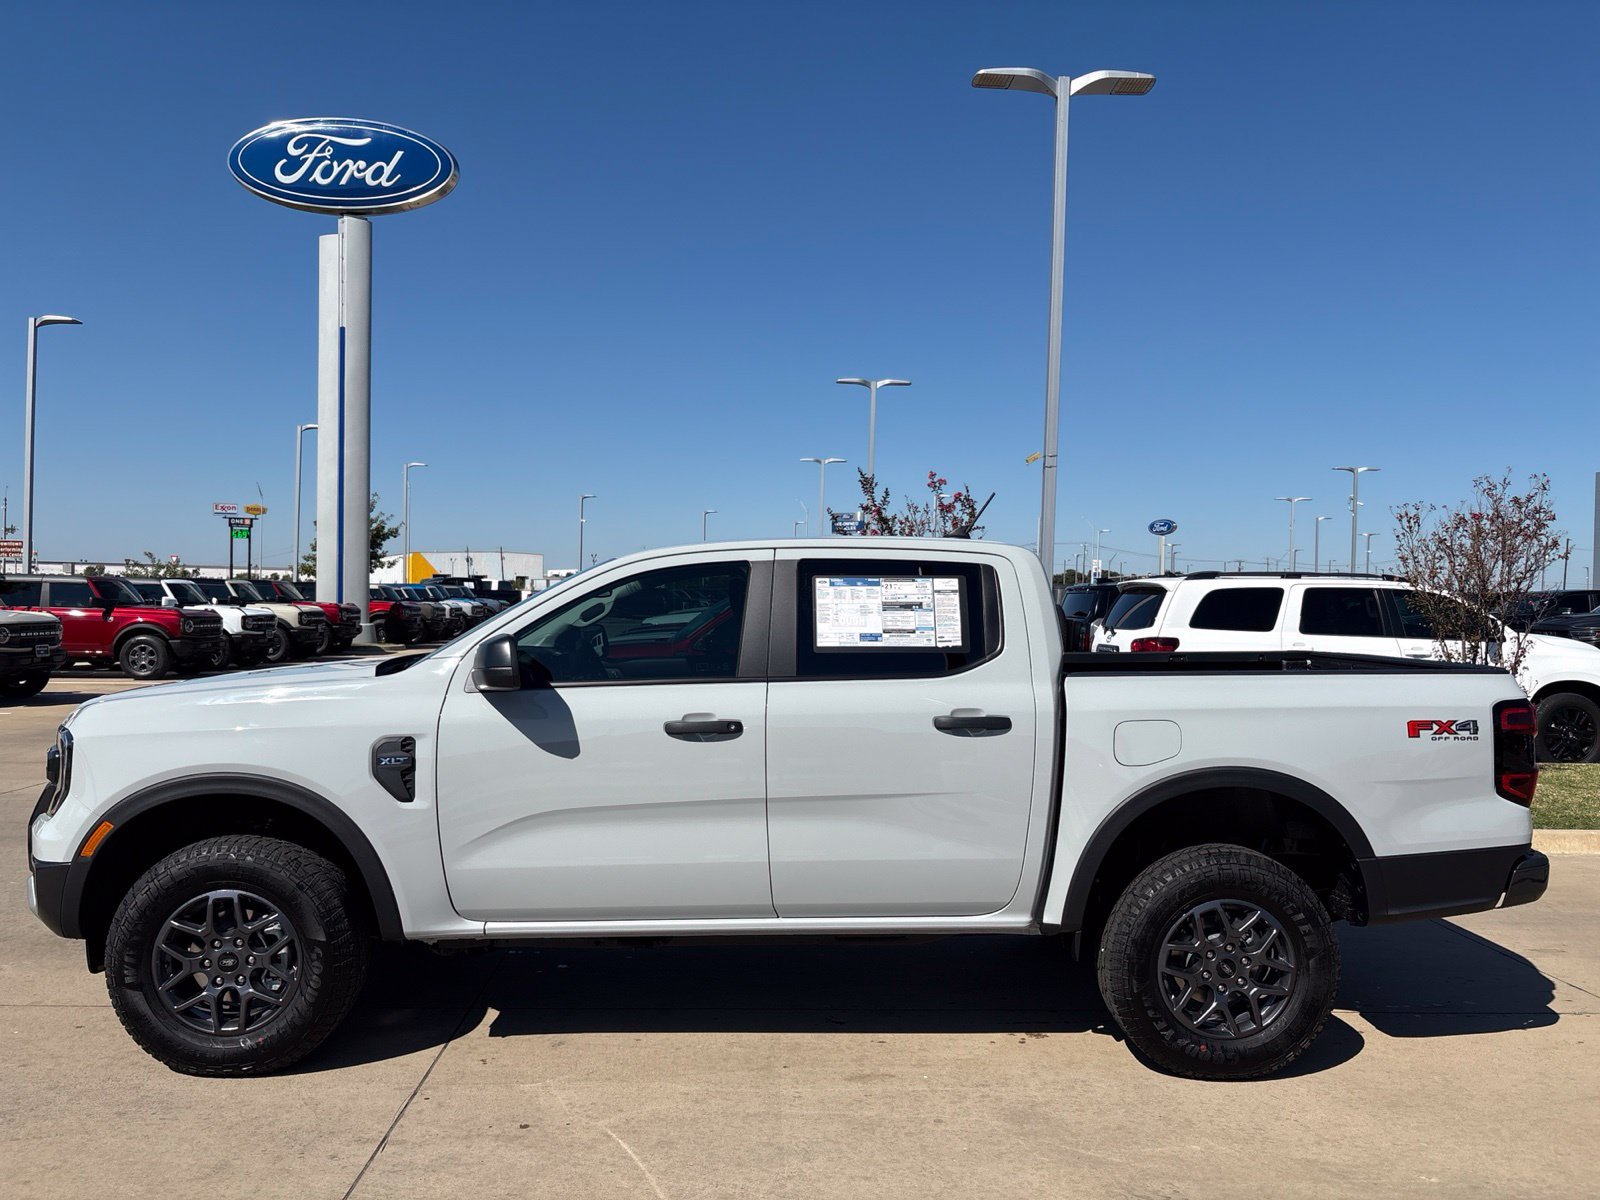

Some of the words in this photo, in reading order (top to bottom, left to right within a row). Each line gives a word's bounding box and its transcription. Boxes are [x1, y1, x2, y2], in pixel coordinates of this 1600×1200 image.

[274, 133, 404, 187] Ford
[215, 504, 237, 512] Exxon
[1153, 522, 1169, 531] Ford
[1407, 720, 1479, 738] FX4
[380, 757, 408, 765] XLT
